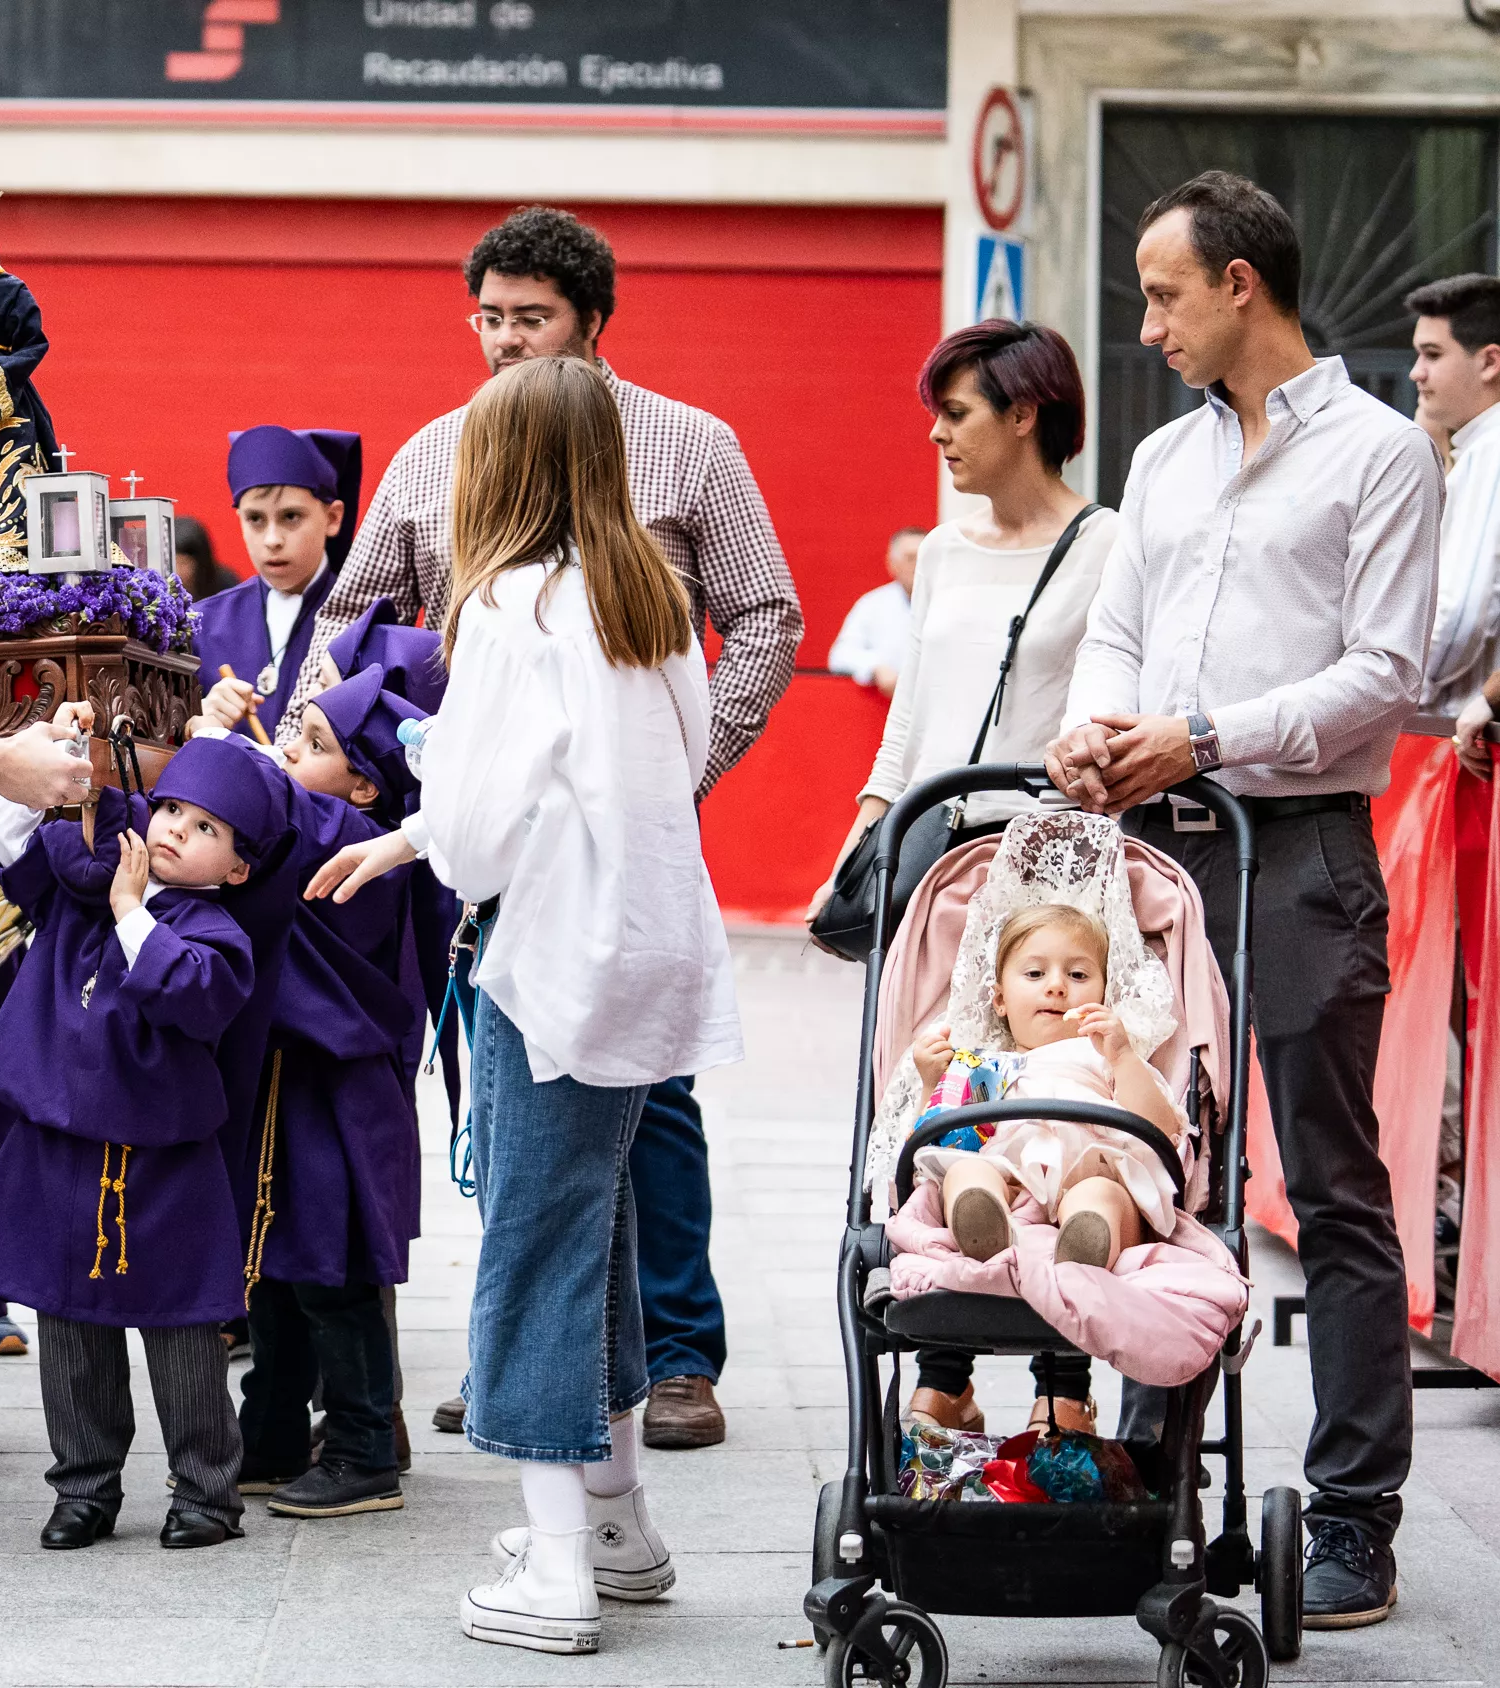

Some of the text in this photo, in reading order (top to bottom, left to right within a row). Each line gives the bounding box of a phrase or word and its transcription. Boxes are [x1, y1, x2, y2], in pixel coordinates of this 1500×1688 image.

[364, 0, 535, 28] Unidad de
[363, 51, 725, 93] Recaudación Ejecutiva
